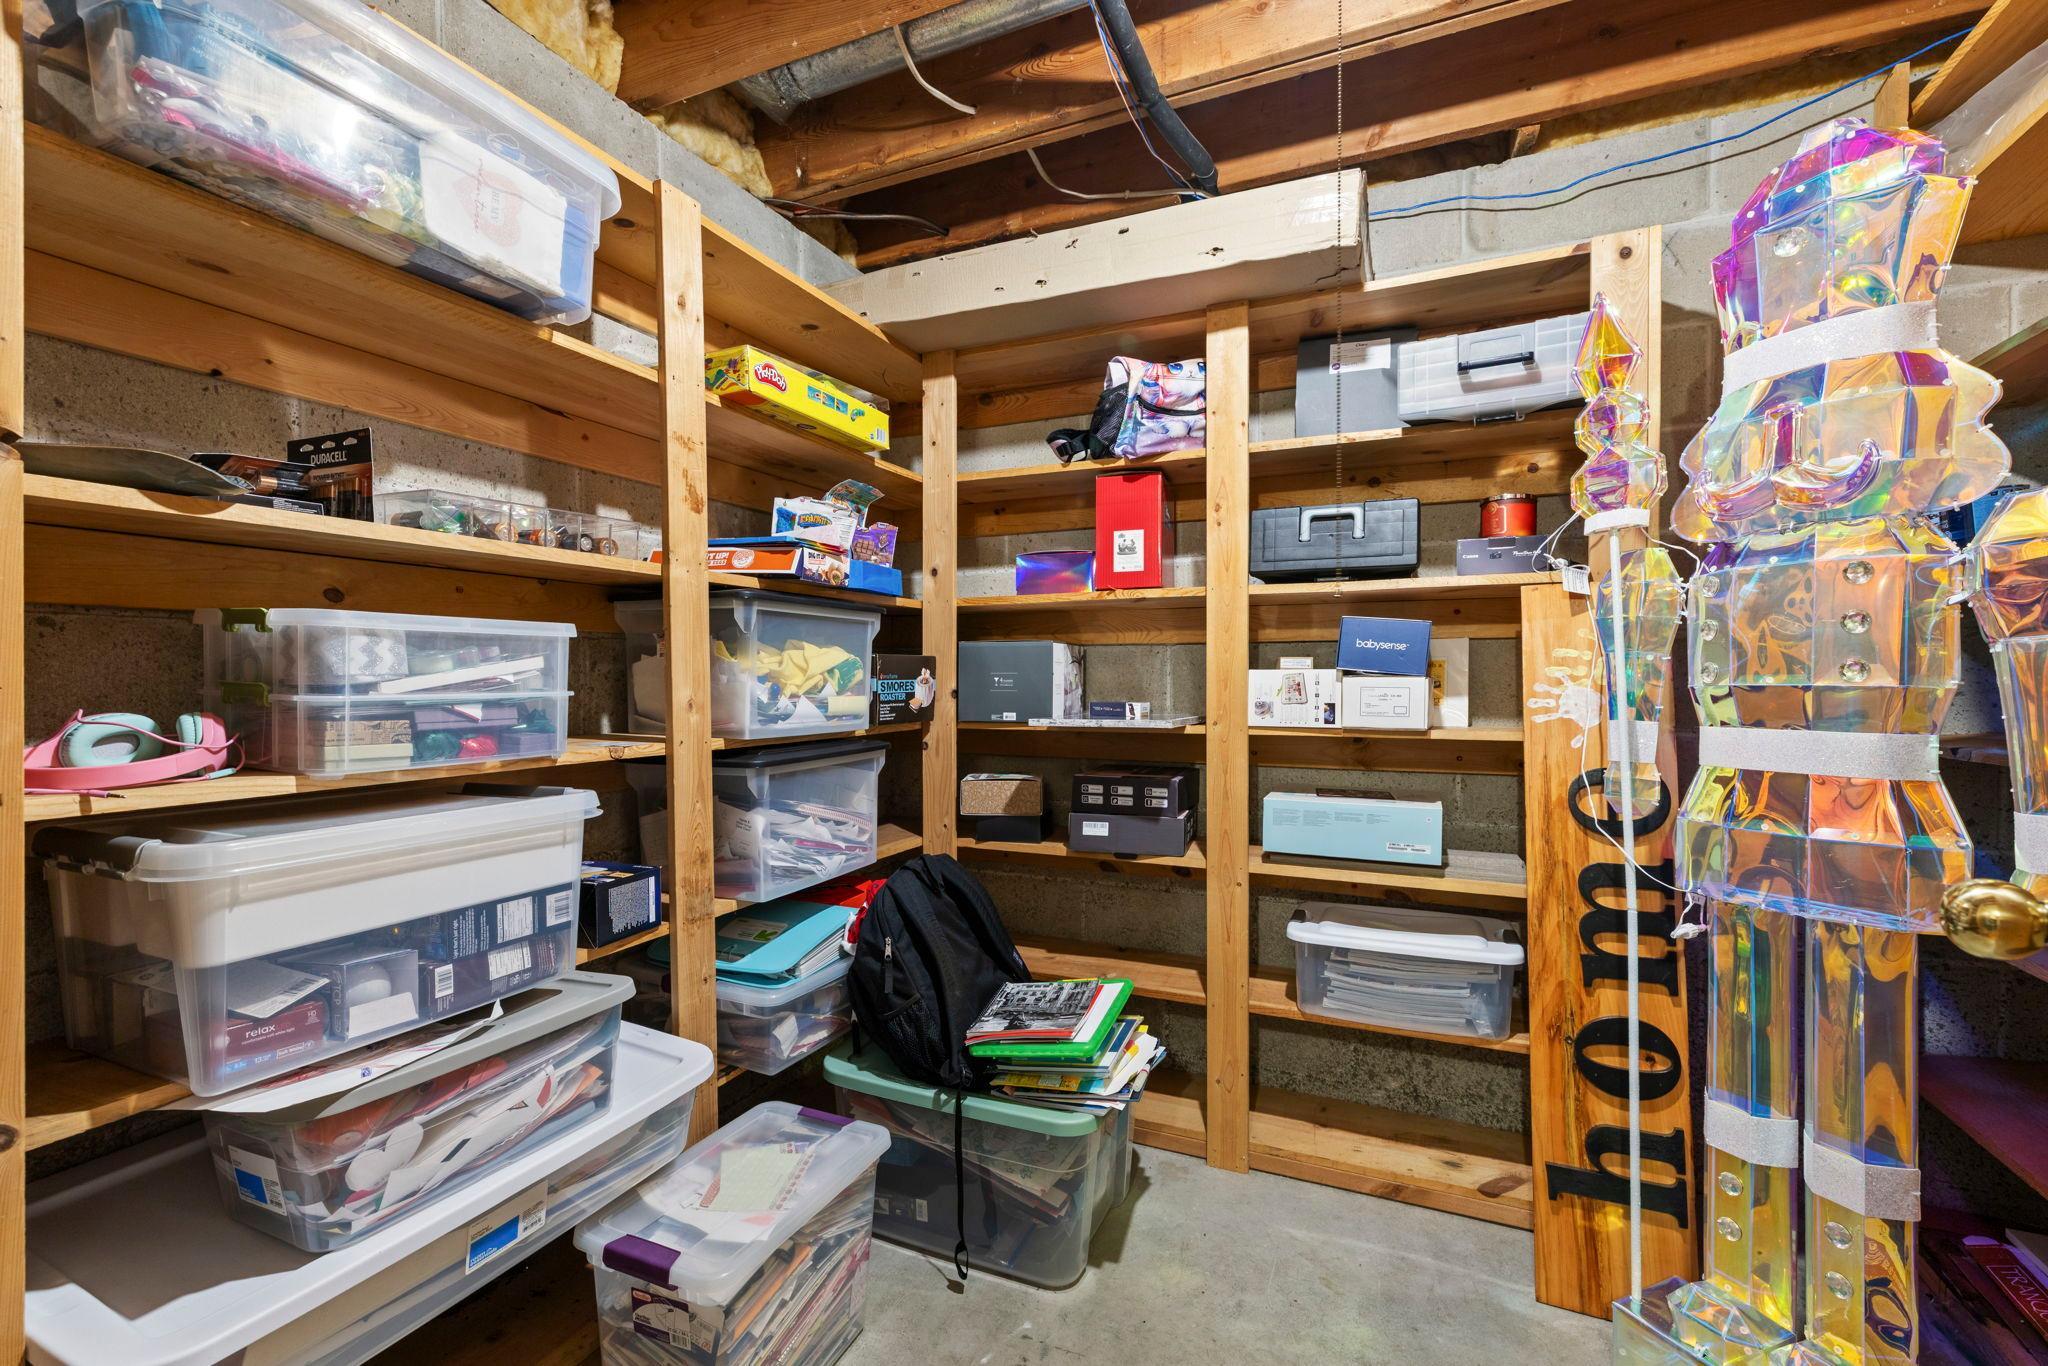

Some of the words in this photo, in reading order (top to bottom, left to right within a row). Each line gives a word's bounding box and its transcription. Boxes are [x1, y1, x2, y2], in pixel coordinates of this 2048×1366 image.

[755, 364, 787, 391] Play-Doh
[310, 451, 348, 465] DURACELL
[1356, 638, 1407, 651] babysense
[880, 692, 906, 702] ROASTER
[1546, 768, 1688, 1229] home
[245, 1024, 276, 1039] relax
